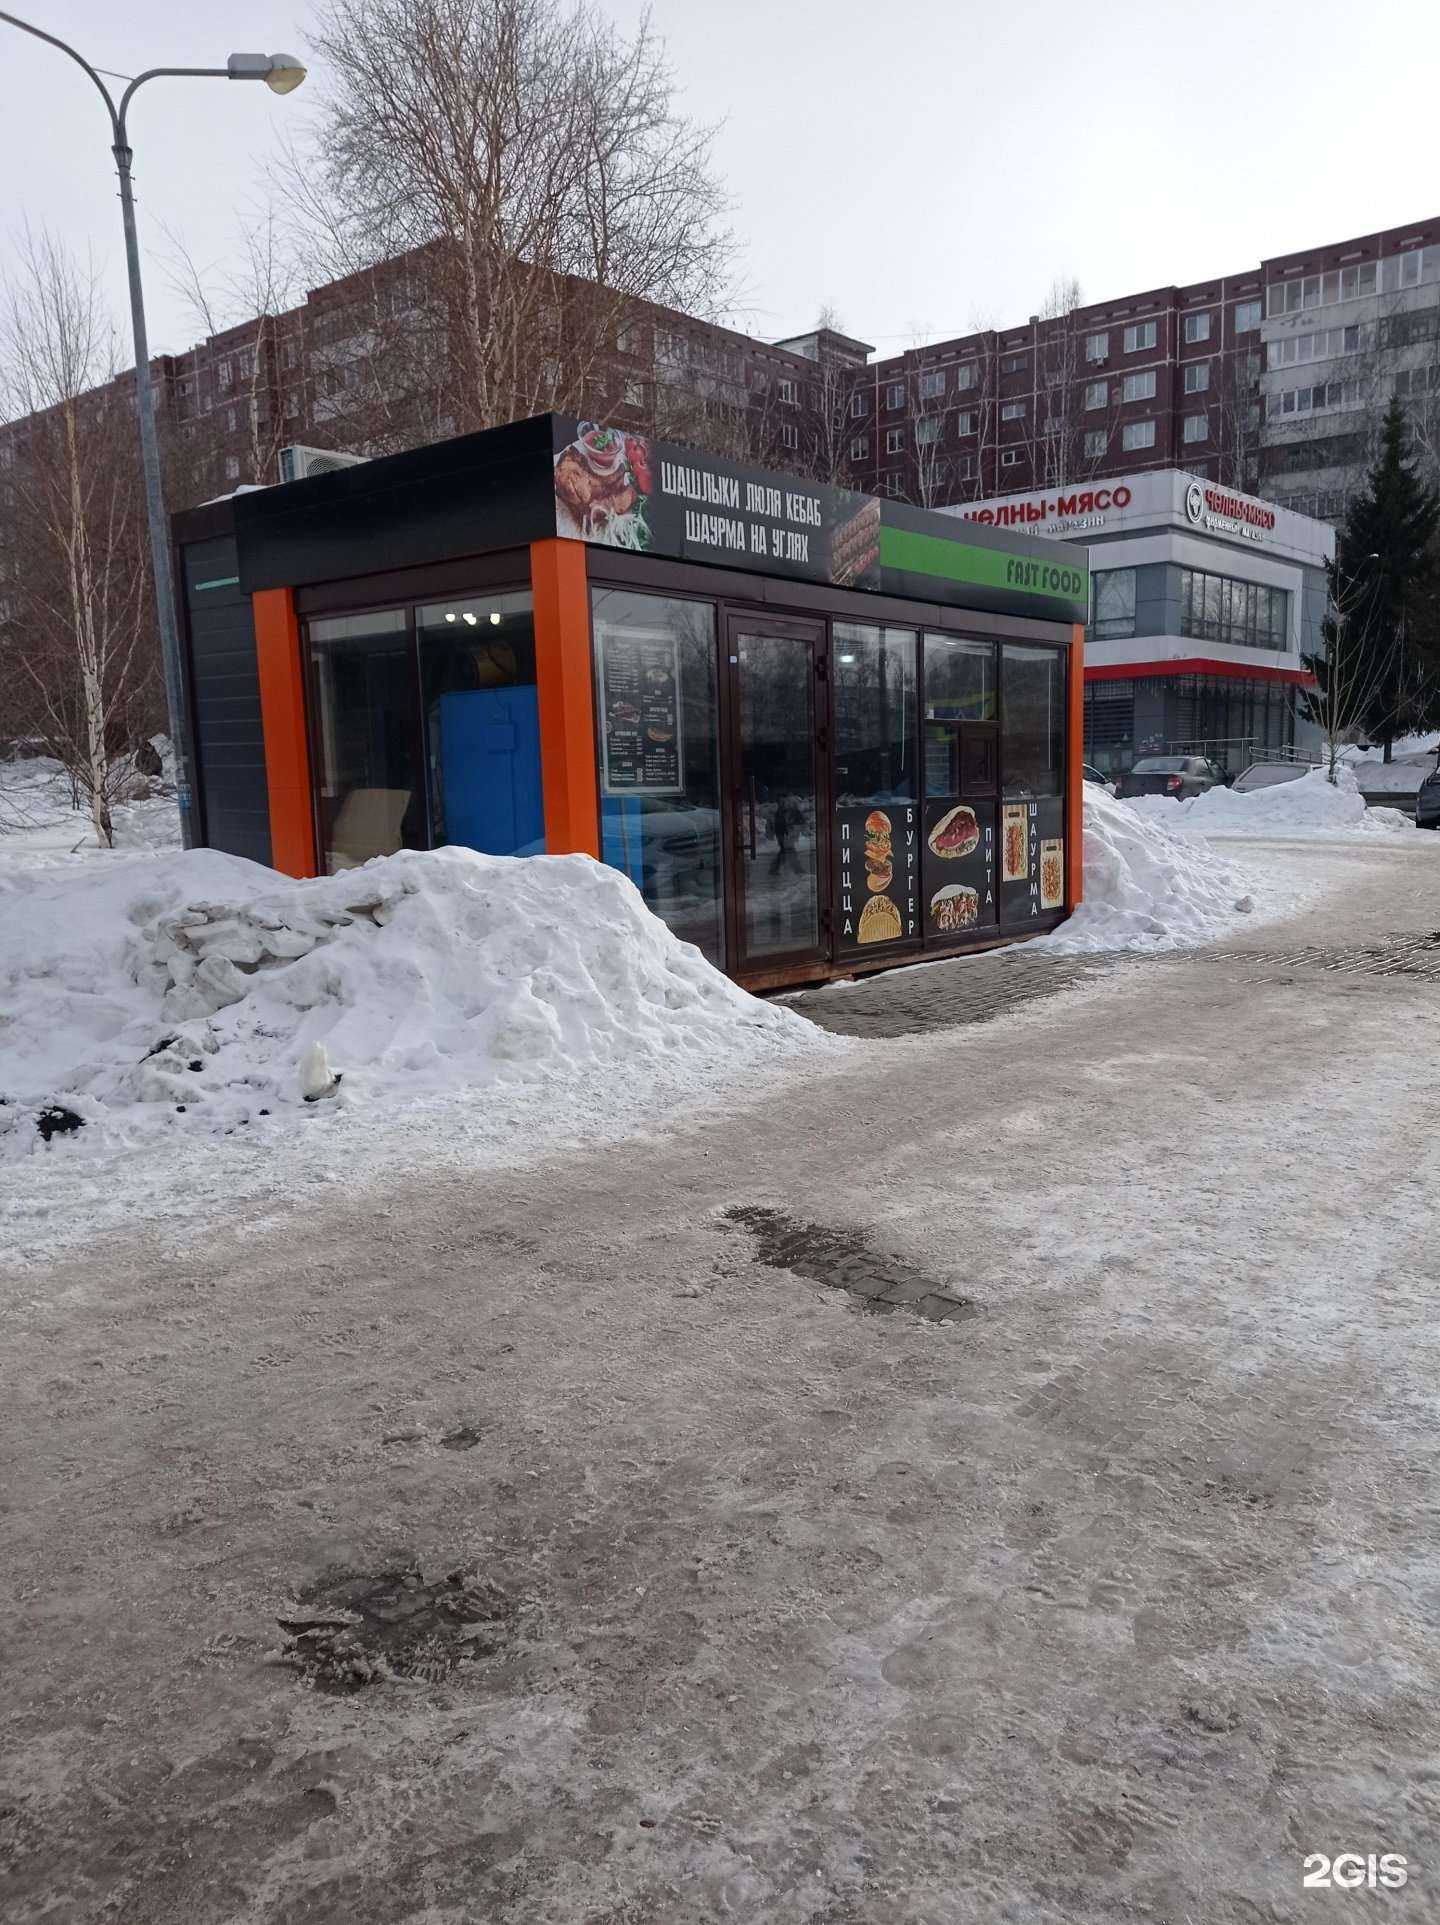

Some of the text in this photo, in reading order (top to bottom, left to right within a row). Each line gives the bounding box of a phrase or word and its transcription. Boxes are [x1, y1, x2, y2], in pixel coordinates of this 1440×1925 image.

[661, 461, 822, 527] ШАШЛЫКИ ЛЮЛЯ КЕБАБ
[685, 510, 809, 563] ШАУРМА НА УГЛЯХ
[1007, 559, 1082, 594] FAST FOOD
[841, 824, 853, 935] ПИЦЦА
[906, 807, 915, 936] БУРГЕР
[985, 827, 993, 905] ПИТА
[1029, 803, 1038, 916] ШАУРМА
